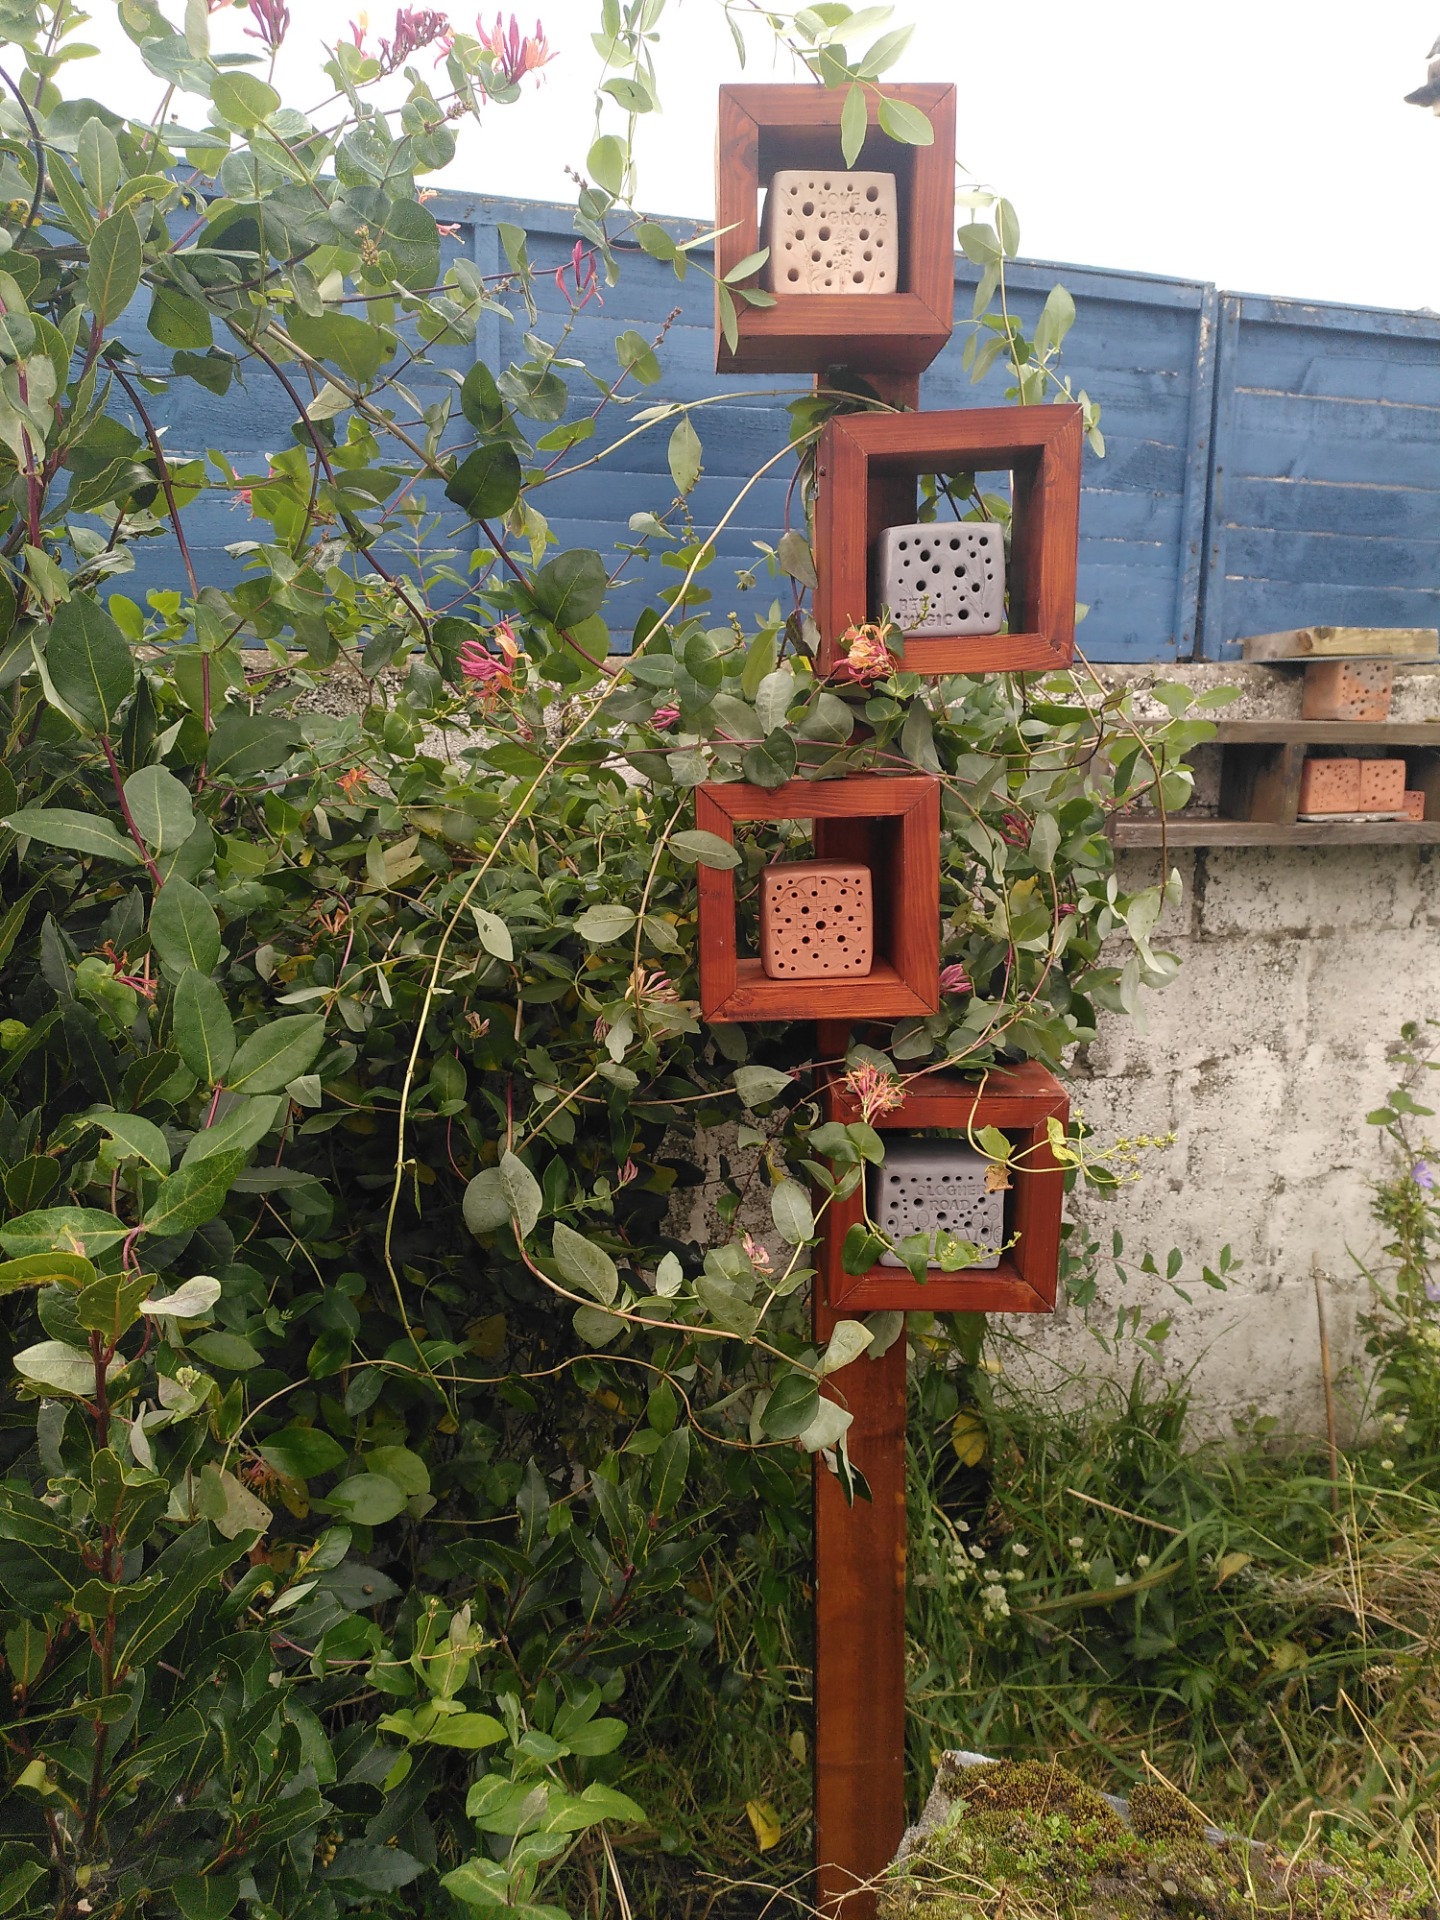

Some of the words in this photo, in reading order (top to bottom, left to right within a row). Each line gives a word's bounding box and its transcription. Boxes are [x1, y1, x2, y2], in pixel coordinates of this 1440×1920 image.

[818, 191, 861, 205] LOVE
[829, 211, 888, 227] GROWS
[929, 1199, 970, 1211] ROAD
